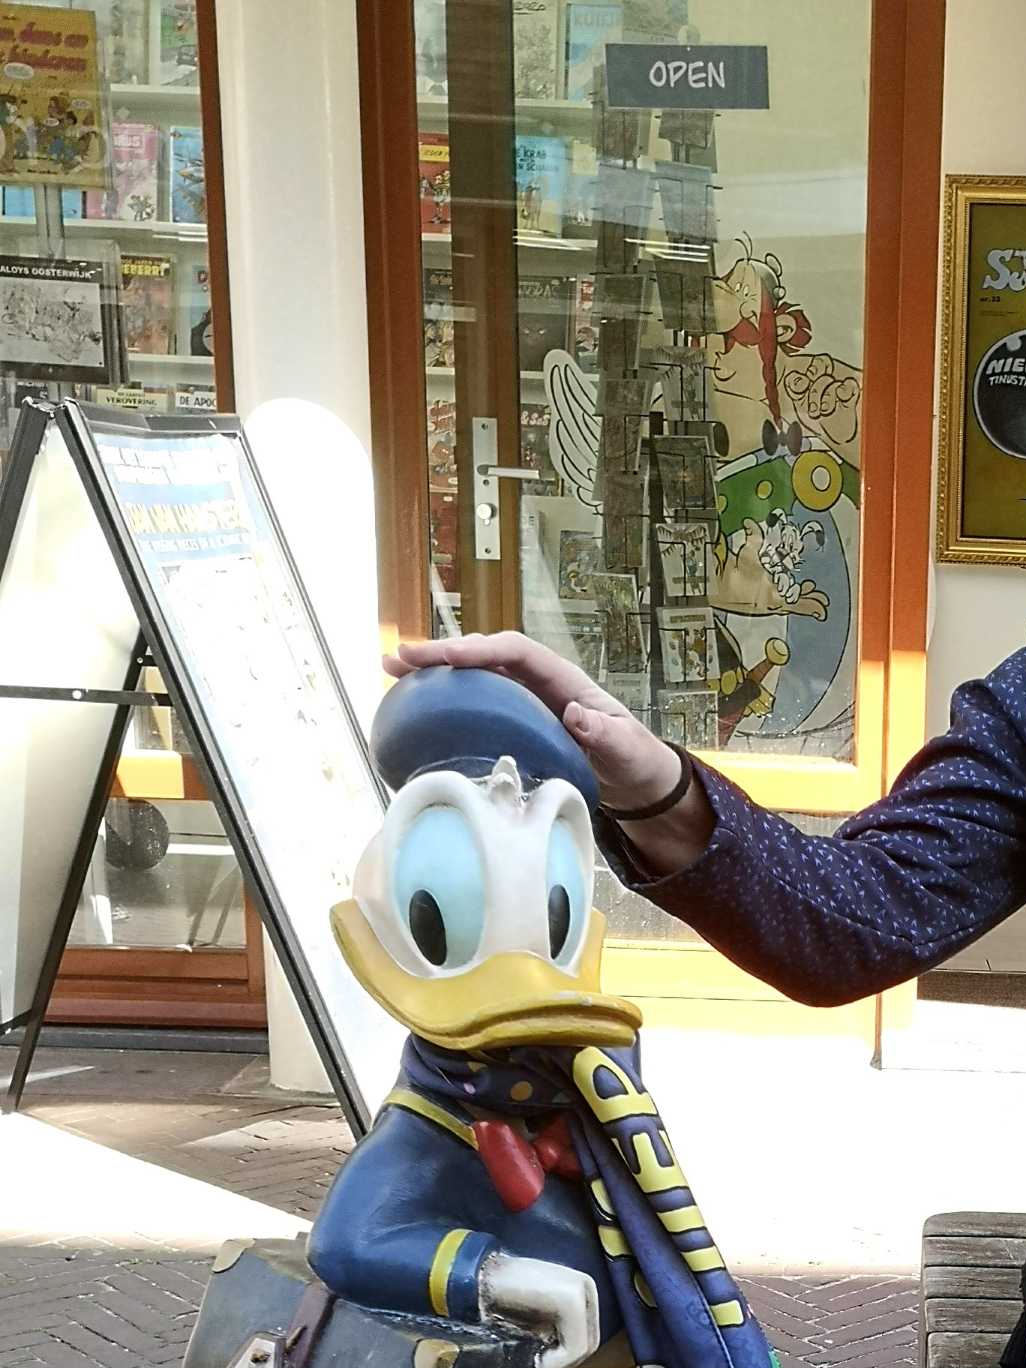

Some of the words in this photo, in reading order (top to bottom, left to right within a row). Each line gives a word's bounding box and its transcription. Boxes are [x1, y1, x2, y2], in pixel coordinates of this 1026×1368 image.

[649, 60, 726, 89] OPEN
[0, 266, 29, 276] ALOYS
[32, 268, 92, 279] OOSTERWIJK
[179, 395, 191, 405] DE
